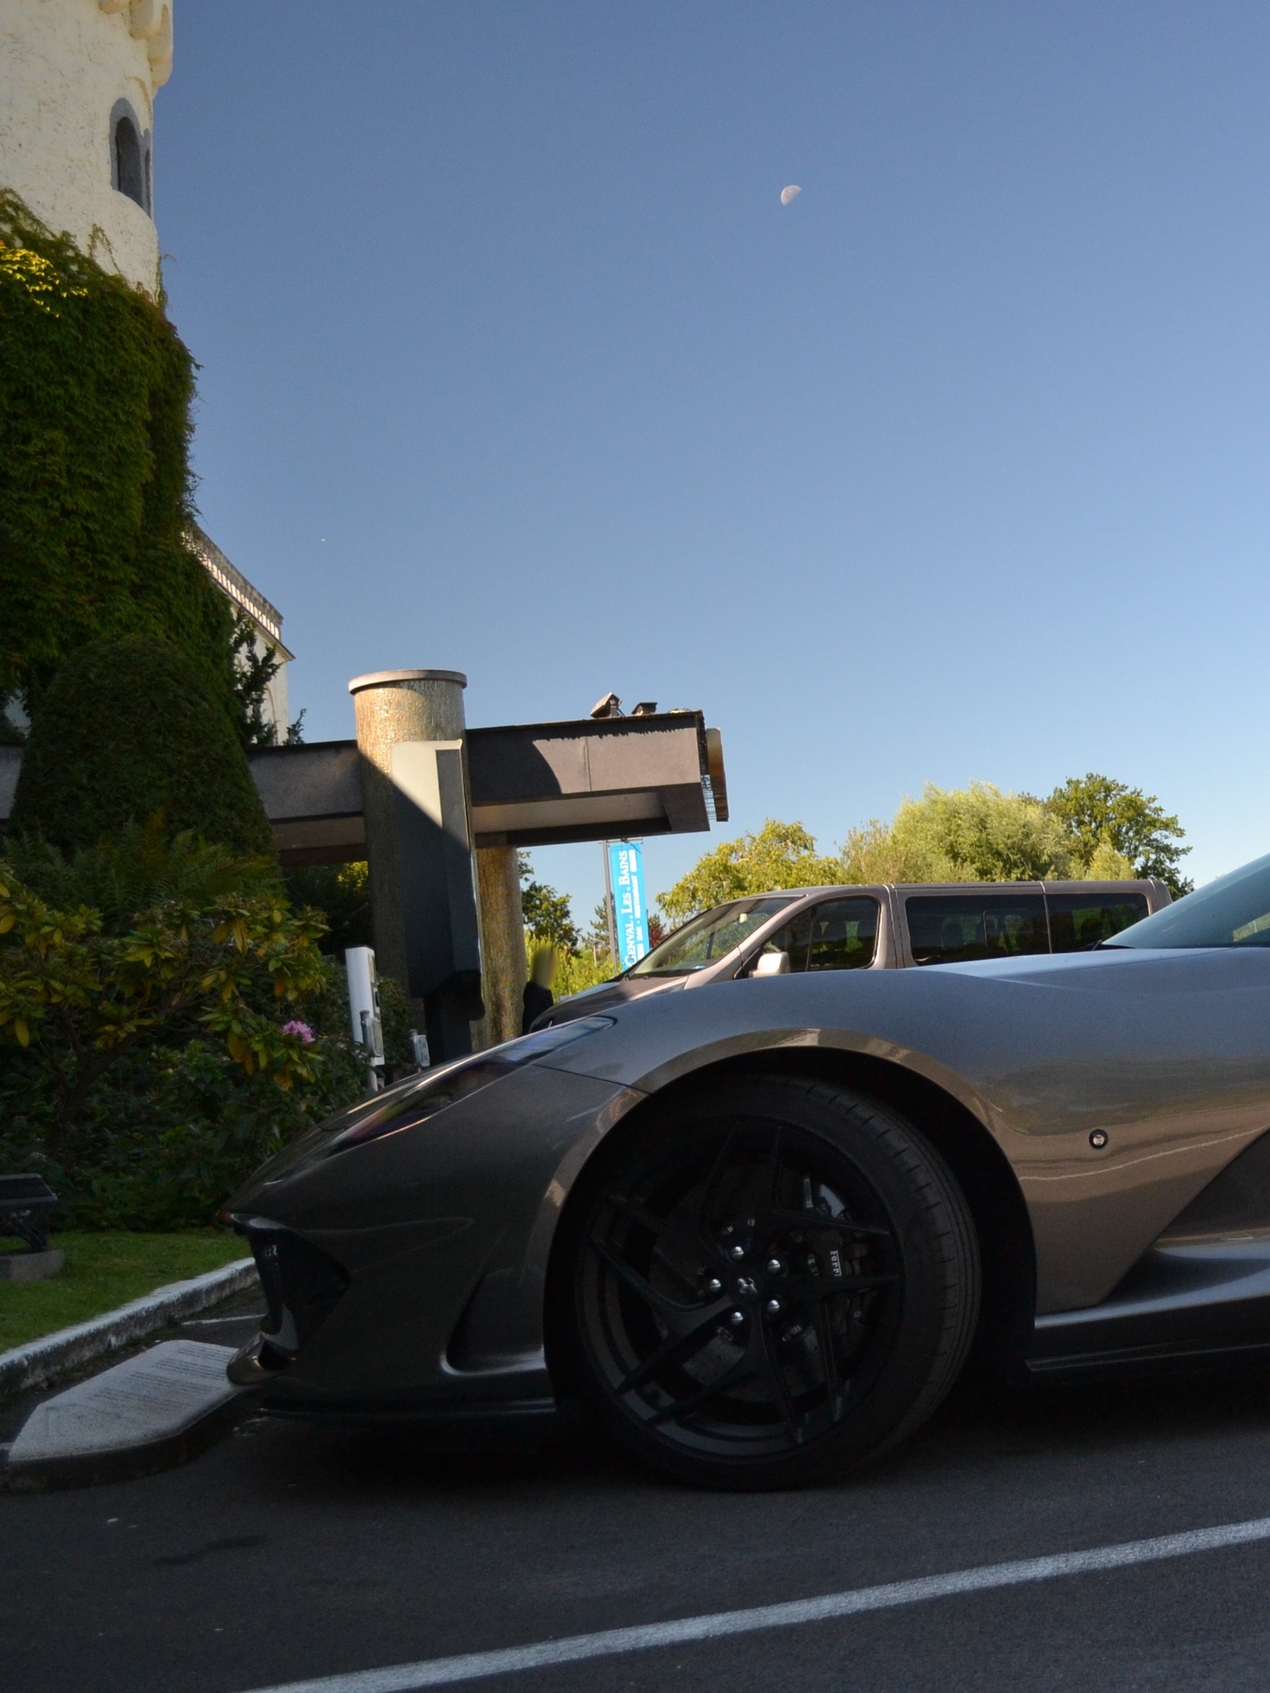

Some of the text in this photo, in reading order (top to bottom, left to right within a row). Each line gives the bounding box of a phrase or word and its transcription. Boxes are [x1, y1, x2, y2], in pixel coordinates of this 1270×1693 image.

[618, 850, 637, 967] GENVAL LES BAINS
[830, 1250, 842, 1277] Ferr
